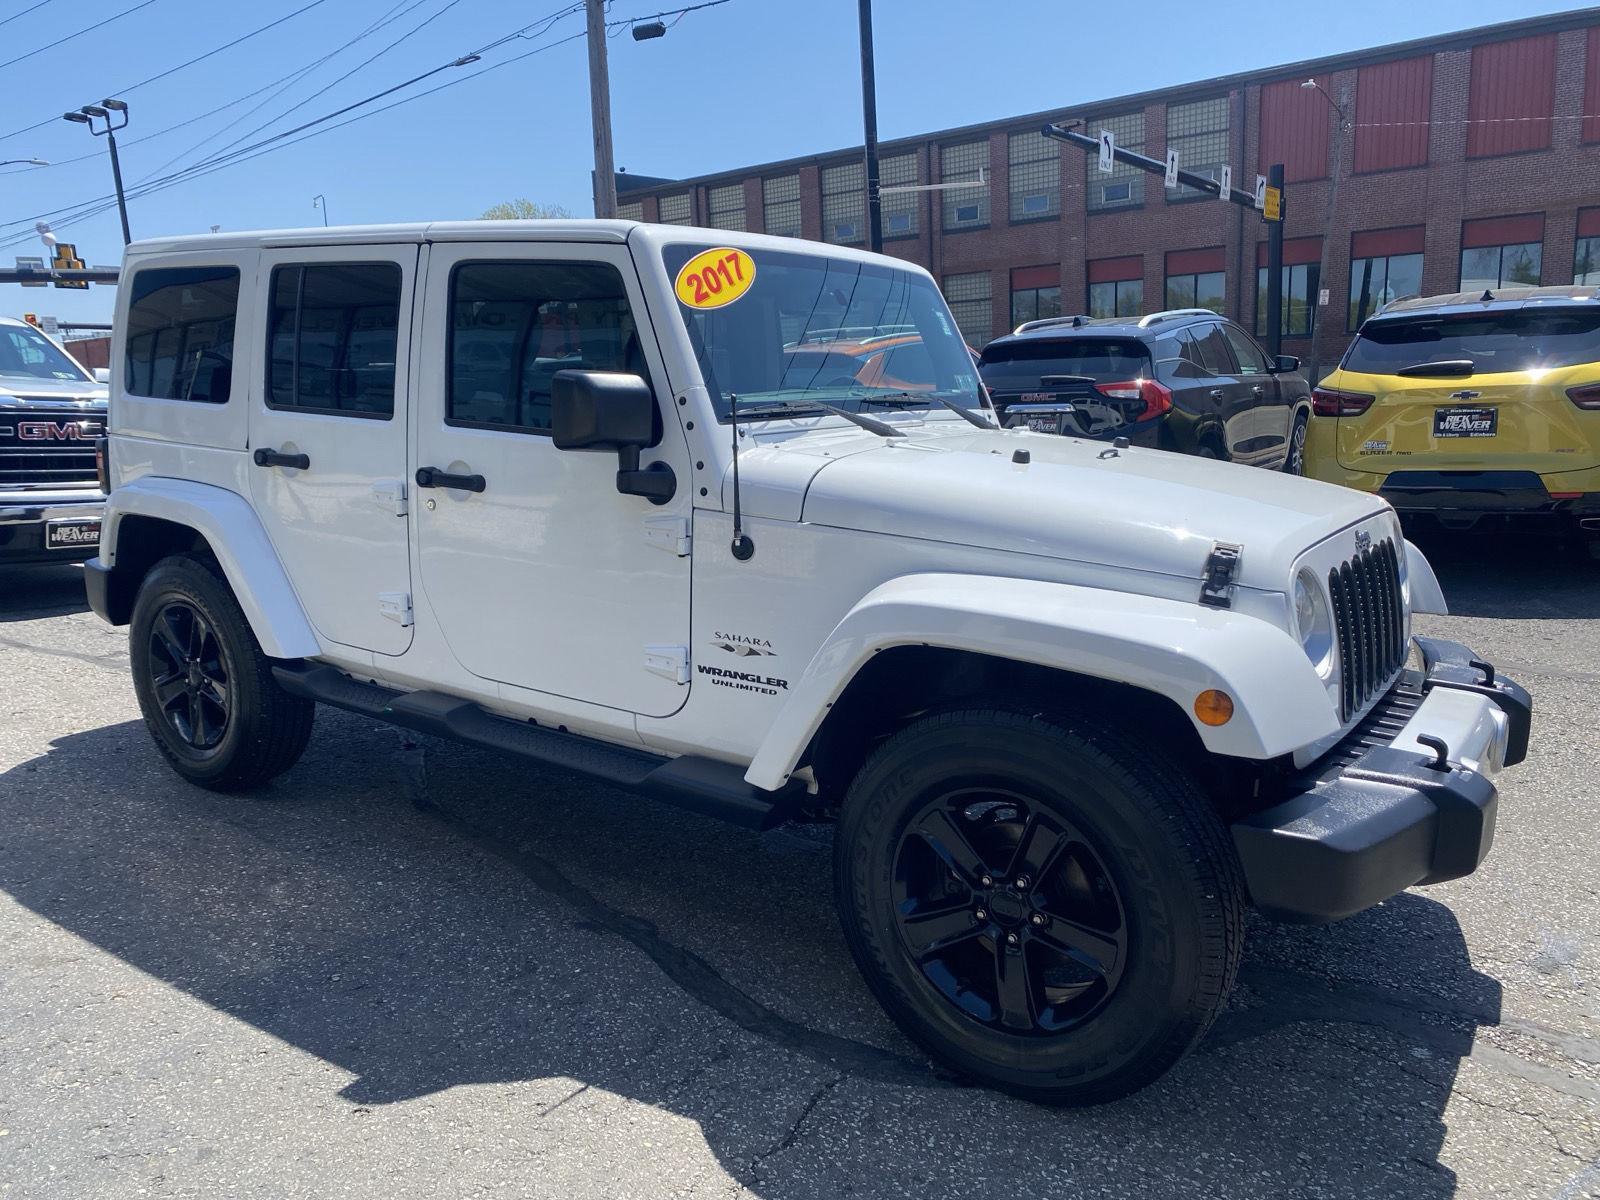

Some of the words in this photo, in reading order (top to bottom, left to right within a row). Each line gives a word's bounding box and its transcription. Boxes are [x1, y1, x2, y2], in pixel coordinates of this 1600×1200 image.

[686, 251, 744, 304] 2017
[1439, 421, 1491, 430] WEAVER
[1445, 414, 1471, 423] RICK
[18, 421, 102, 440] GMC
[51, 531, 100, 542] WEAVER
[714, 631, 772, 648] SAHARA
[697, 664, 789, 690] WRANGLER
[711, 678, 778, 696] UNLIMITED
